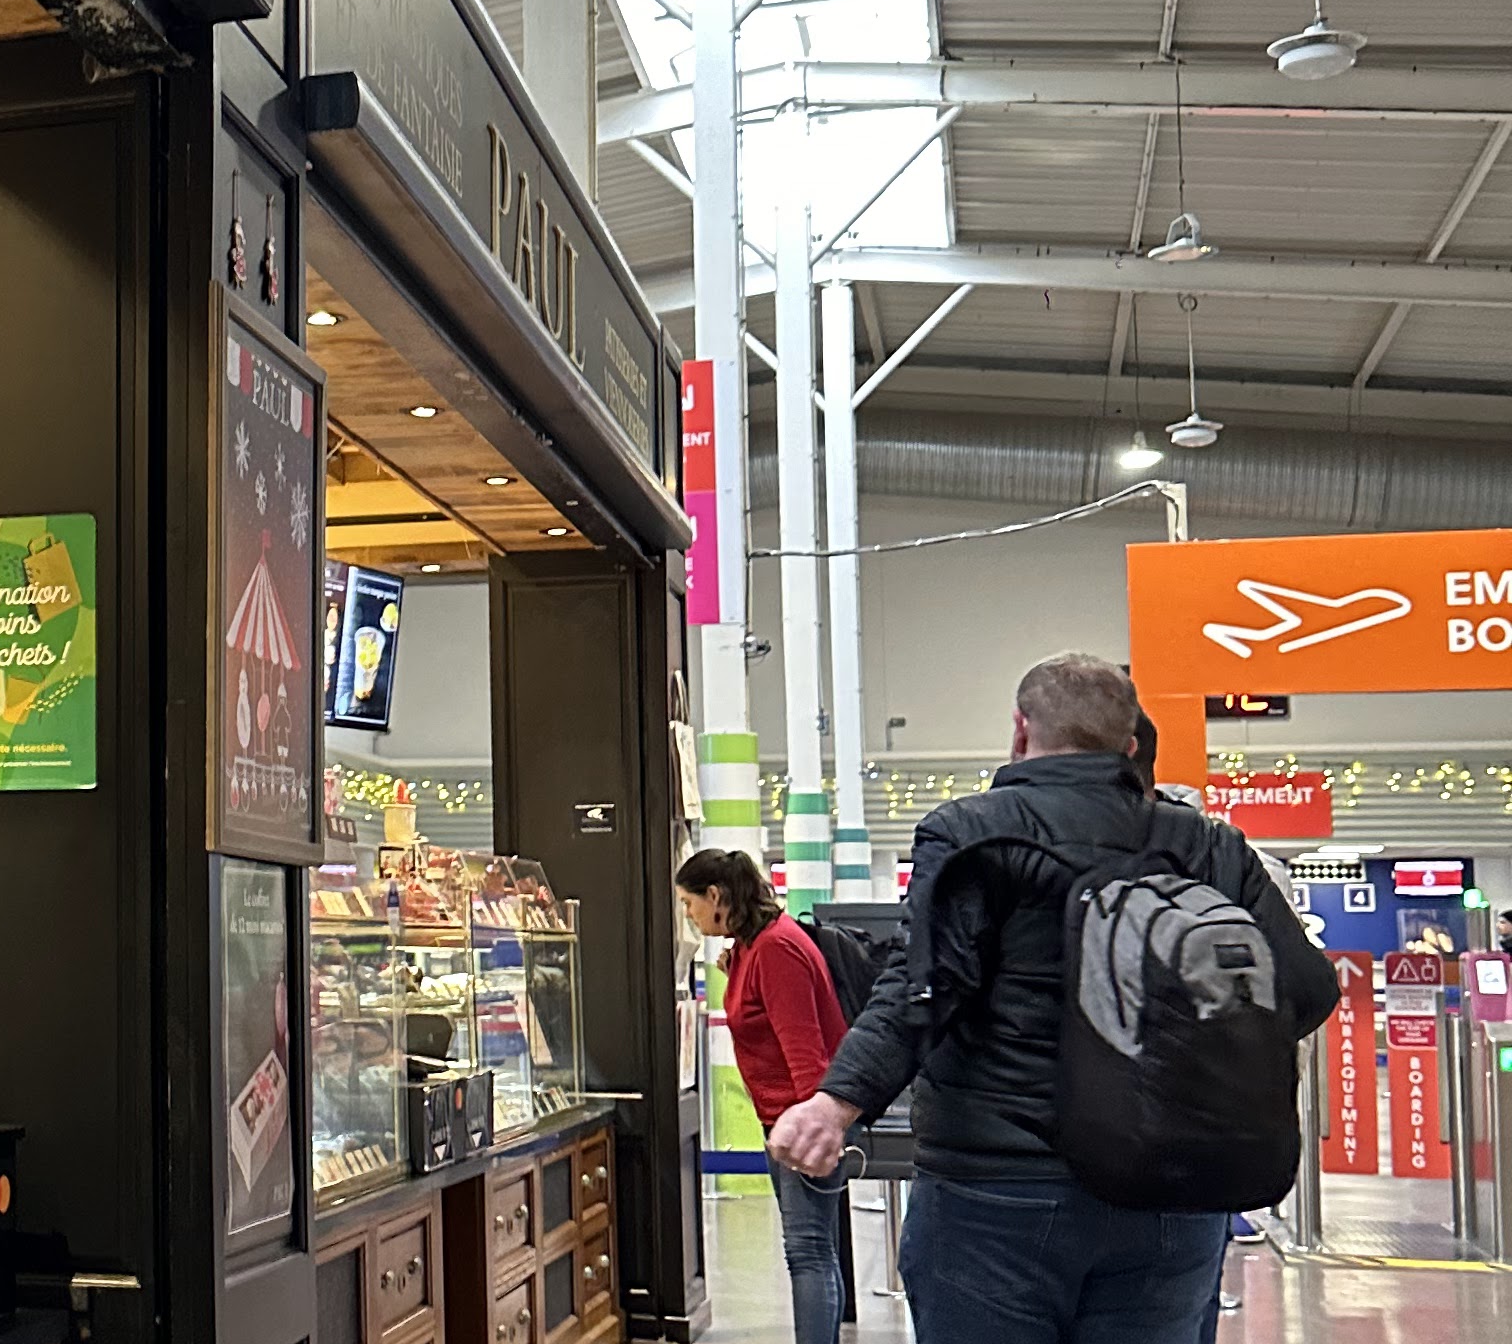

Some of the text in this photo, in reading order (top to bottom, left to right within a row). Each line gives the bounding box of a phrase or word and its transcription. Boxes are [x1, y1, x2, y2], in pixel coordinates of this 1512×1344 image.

[393, 59, 463, 198] FANTAISIE
[487, 121, 586, 373] PAUL
[252, 369, 289, 427] PAUL
[1338, 997, 1358, 1164] EMBARQUEMENT
[1408, 1056, 1426, 1169] BOARDING
